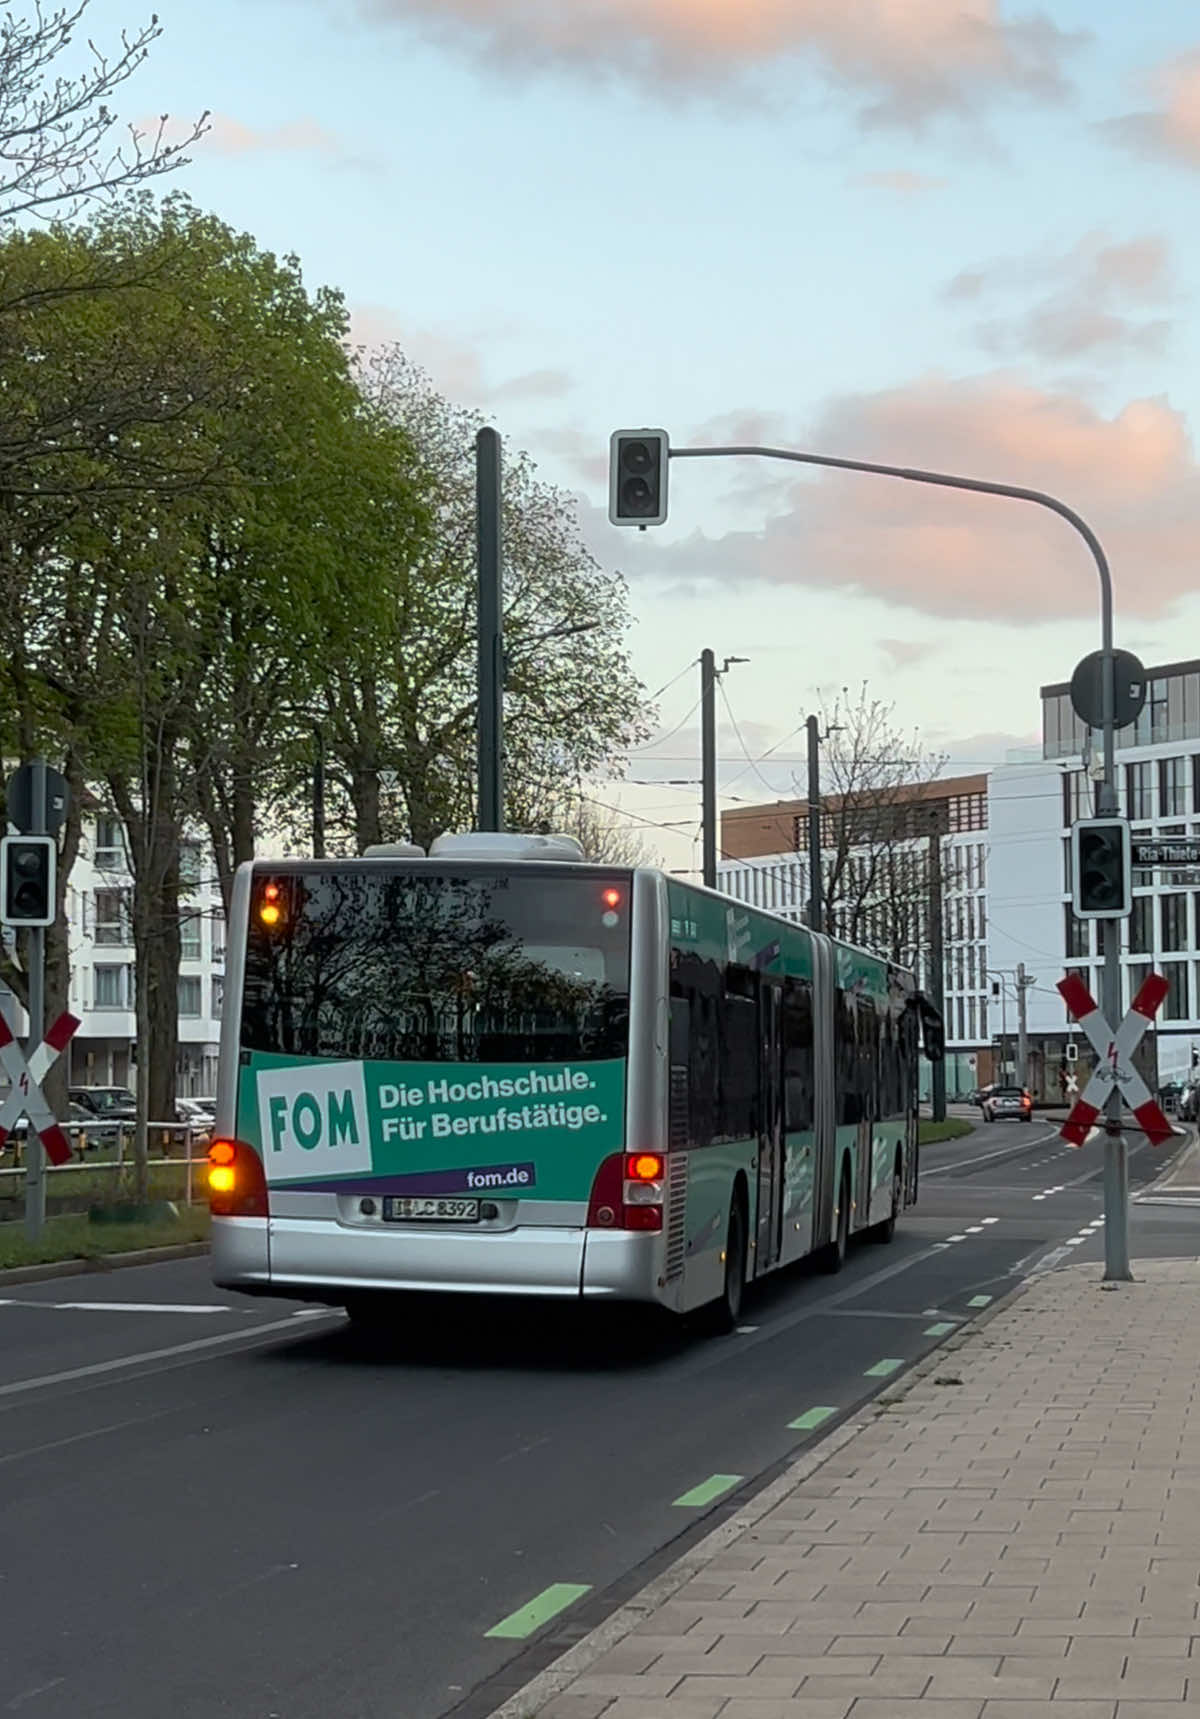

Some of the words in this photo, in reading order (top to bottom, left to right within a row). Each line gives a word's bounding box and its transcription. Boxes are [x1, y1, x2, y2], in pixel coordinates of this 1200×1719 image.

[378, 1083, 424, 1110] Die
[427, 1066, 597, 1104] Hochschule.
[269, 1088, 360, 1152] FOM
[381, 1116, 427, 1143] Für
[431, 1101, 608, 1138] Berufstätige.
[466, 1167, 530, 1188] fom.de
[437, 1200, 476, 1217] 8392
